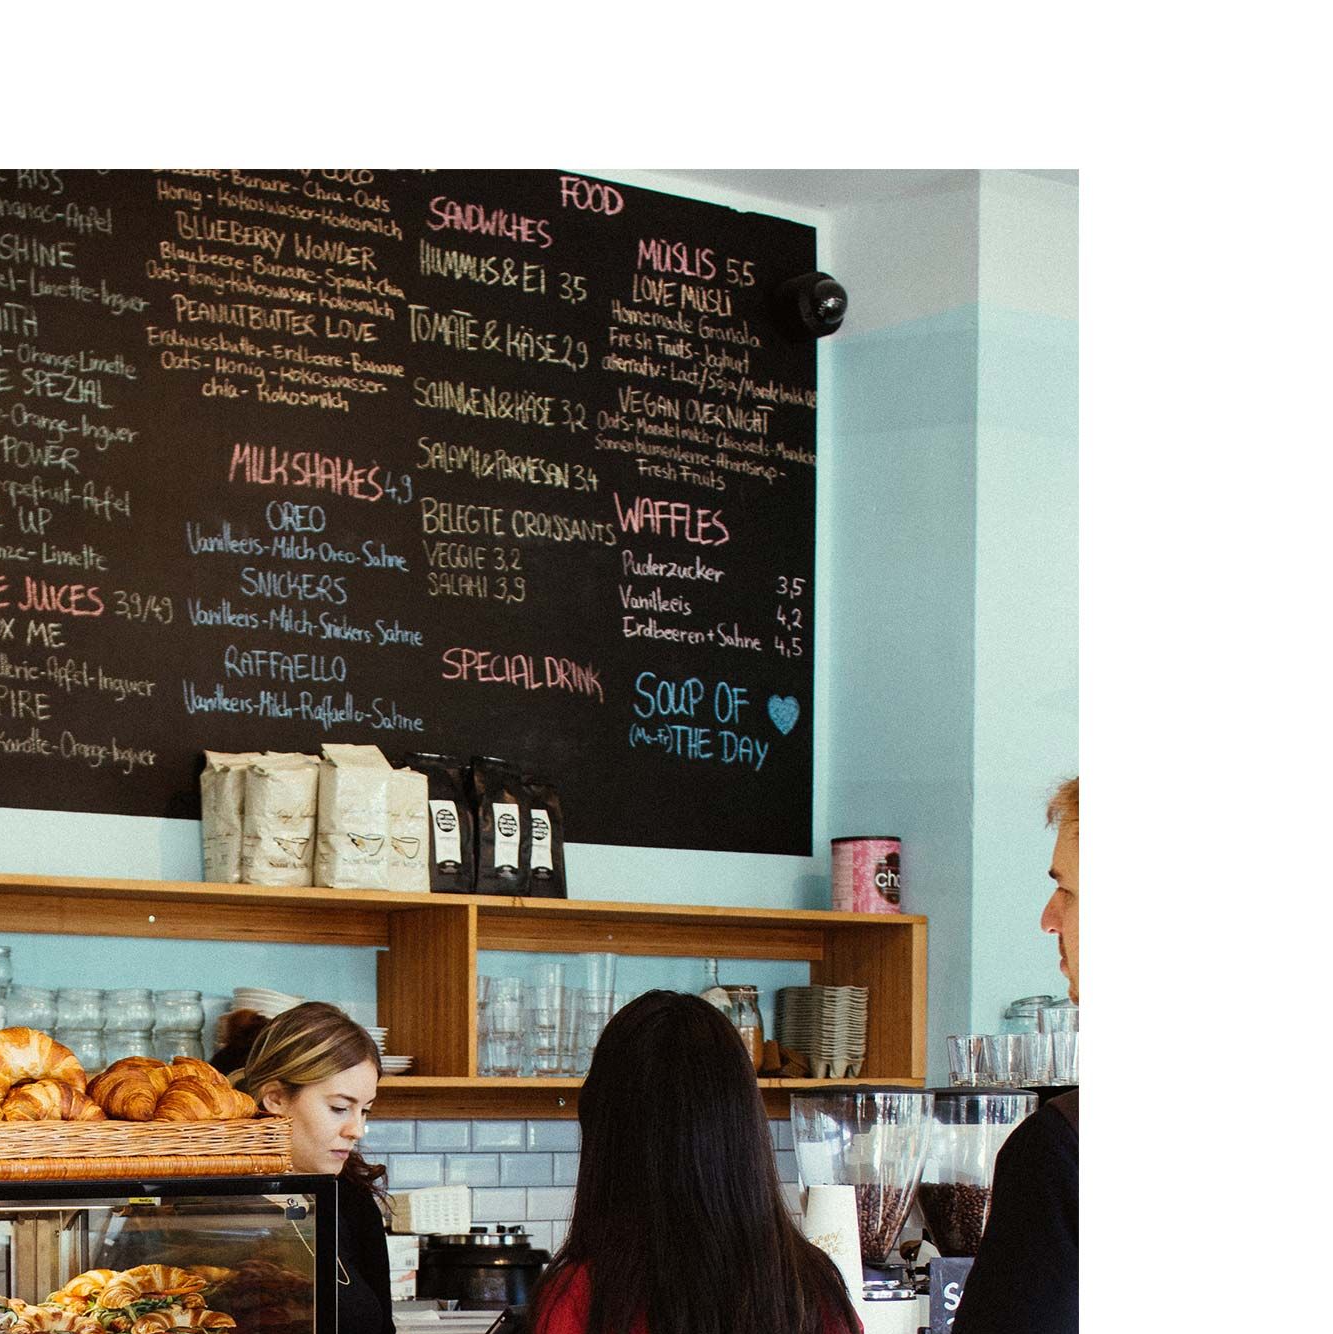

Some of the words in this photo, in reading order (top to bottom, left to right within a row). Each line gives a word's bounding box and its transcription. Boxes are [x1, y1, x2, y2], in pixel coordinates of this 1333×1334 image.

[559, 175, 626, 217] FOOD
[175, 210, 286, 259] BLUEBERRY
[294, 232, 378, 272] WONDER
[426, 196, 554, 249] SANDWICHES
[559, 271, 588, 304] 3,5
[633, 273, 677, 308] LOVE
[726, 258, 757, 289] 5,5
[171, 293, 318, 337] PEANUTBUTTER
[324, 316, 379, 342] LOVE
[407, 304, 480, 351] TOMATE
[560, 334, 590, 372] 2,9
[611, 299, 694, 335] Homemade
[698, 314, 763, 349] Granola
[21, 367, 114, 410] SPEZIAL
[561, 399, 589, 433] 3,2
[618, 384, 680, 421] VEGAN
[686, 398, 774, 436] OVERNIGHT
[385, 471, 413, 505] 4,9
[573, 464, 600, 493] 3,4
[636, 458, 678, 482] Fresh
[680, 466, 726, 491] Fruits
[18, 505, 54, 535] UP
[266, 500, 326, 533] OREO
[420, 497, 506, 535] BELEGTE
[511, 510, 618, 547] CROISSANTS
[614, 492, 730, 547] WAFFLES
[422, 539, 487, 571] VEGGIE
[493, 547, 523, 572] 3,2
[621, 549, 726, 583] Puderzucker
[776, 575, 806, 600] 3,5
[17, 575, 105, 617] JUICES
[240, 567, 348, 605] SNICKERS
[428, 572, 488, 598] SALAMI
[493, 576, 526, 604] 3,9
[618, 584, 693, 617] Vanilleeis
[776, 605, 804, 632] 4,2
[26, 619, 66, 648] ME
[774, 635, 804, 659] 4,5
[224, 644, 347, 683] RAFFAELLO
[442, 647, 542, 691] SPECIAL
[544, 656, 604, 704] DRINK
[633, 671, 704, 719] SOUP
[714, 681, 751, 724] OF
[670, 725, 714, 761] THE
[718, 730, 770, 773] DAY
